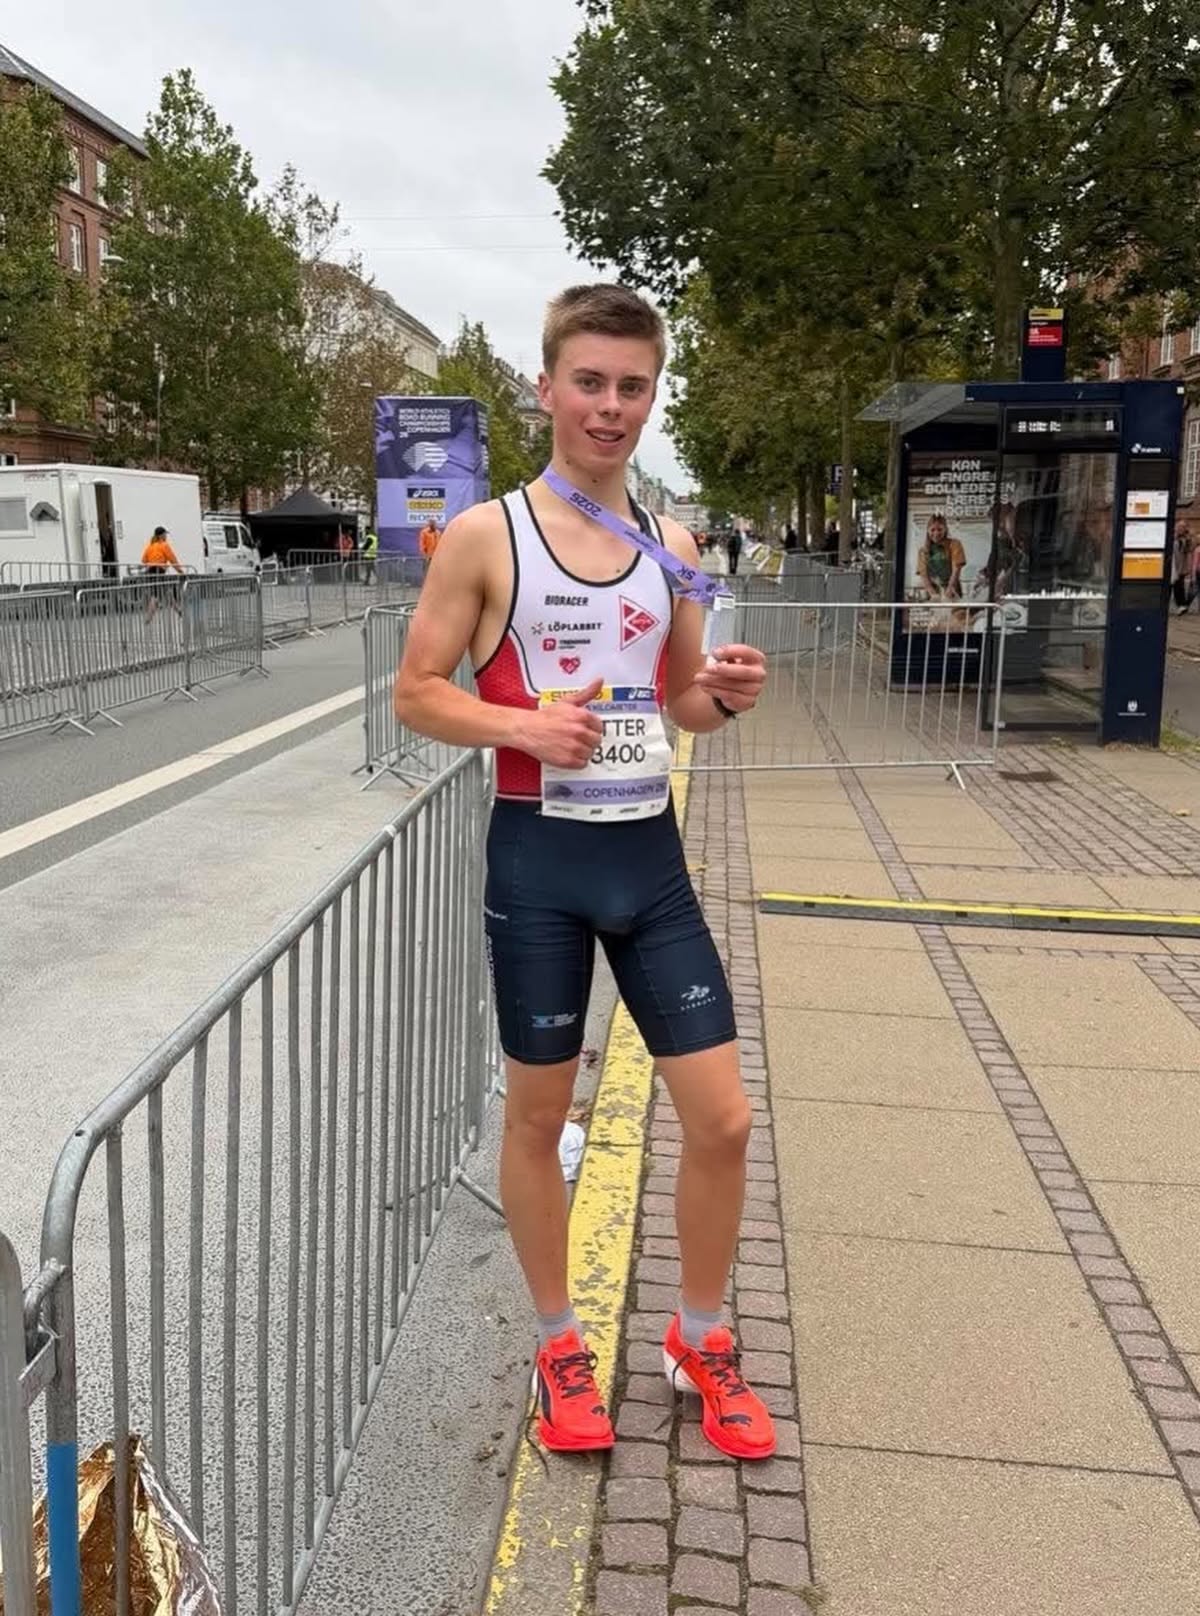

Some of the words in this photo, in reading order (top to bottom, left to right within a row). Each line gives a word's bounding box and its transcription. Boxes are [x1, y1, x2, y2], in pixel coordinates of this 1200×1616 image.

[952, 460, 981, 471] KAN
[545, 595, 589, 606] BIORACER
[548, 621, 602, 632] LÖPLABBET
[602, 719, 647, 736] TTER
[583, 784, 655, 798] COPENHAGEN
